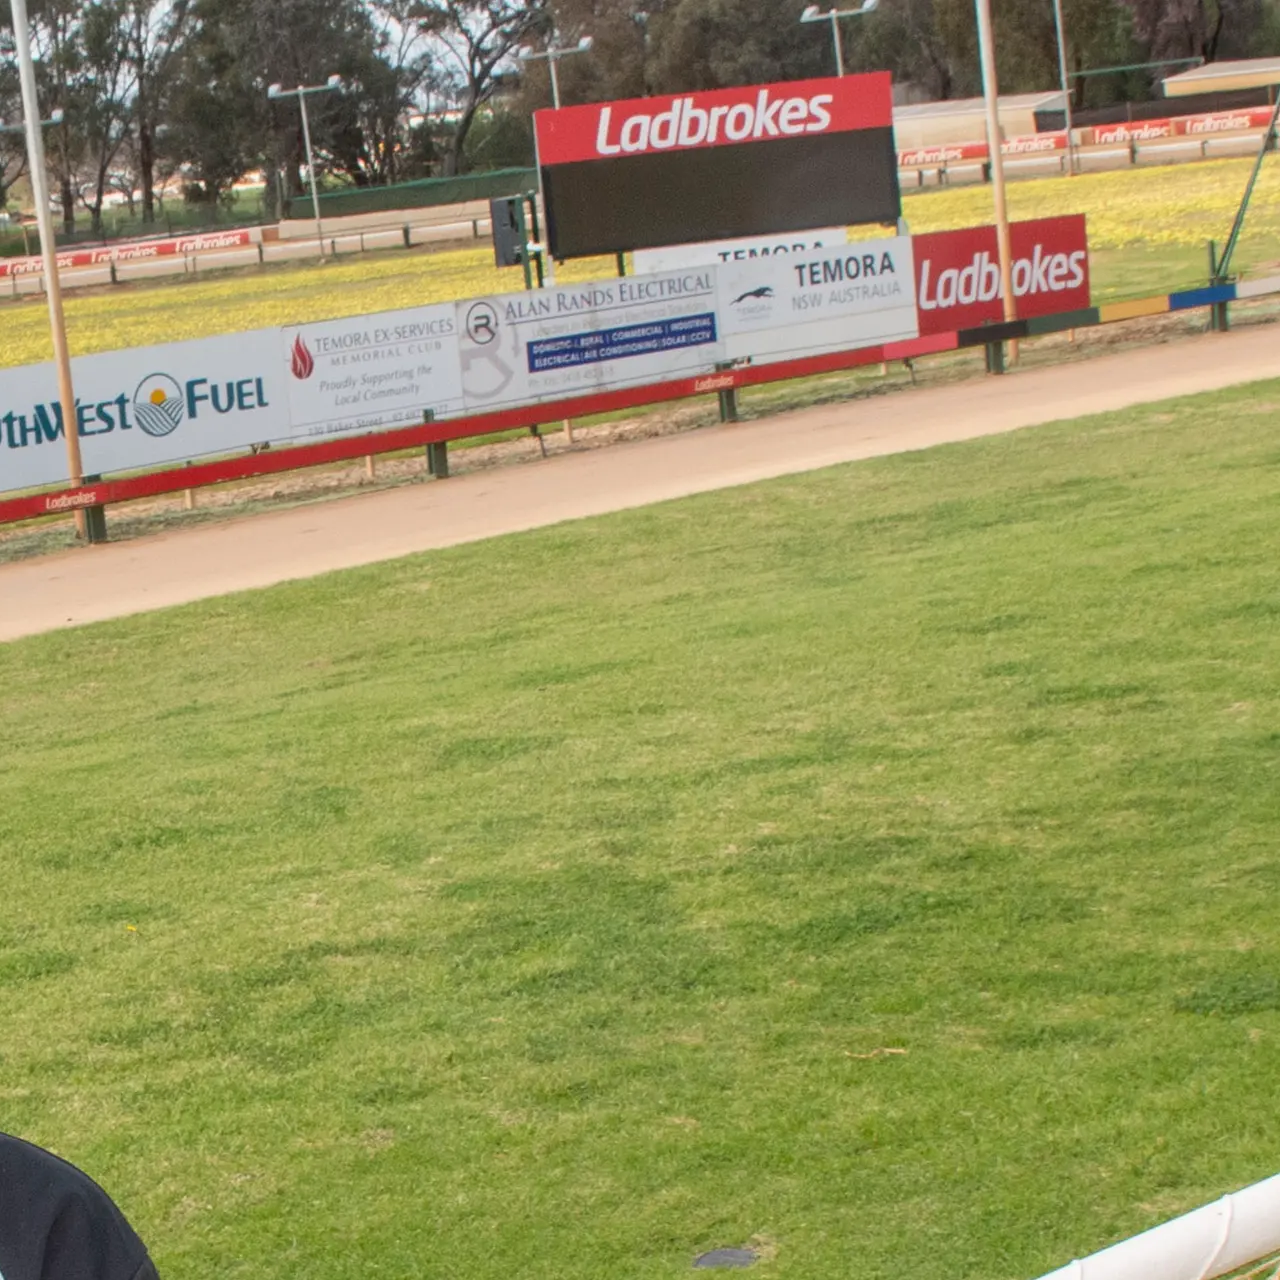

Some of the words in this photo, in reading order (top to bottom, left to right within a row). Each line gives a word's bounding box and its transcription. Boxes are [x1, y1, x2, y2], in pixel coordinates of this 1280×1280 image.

[595, 88, 834, 155] Ladbrokes
[1000, 137, 1056, 154] adbrokes
[794, 250, 896, 288] TEMORA
[505, 296, 552, 321] ALAN
[557, 288, 615, 313] RANDS
[619, 272, 715, 303] ELECTRICAL
[792, 293, 823, 312] NSW
[828, 281, 902, 306] AUSTRALIA
[315, 331, 371, 354] TEMORA
[374, 318, 455, 343] EX-SERVICES
[612, 326, 664, 342] COMMERCIAL
[330, 347, 402, 367] MEMORIAL
[408, 340, 443, 355] CLUB
[533, 354, 580, 369] ELECTRICAL
[319, 374, 358, 392] Proudly
[361, 366, 415, 389] Supporting
[417, 364, 433, 377] the
[334, 392, 362, 407] Local
[363, 384, 421, 403] Community
[45, 489, 97, 511] Ladbrokes
